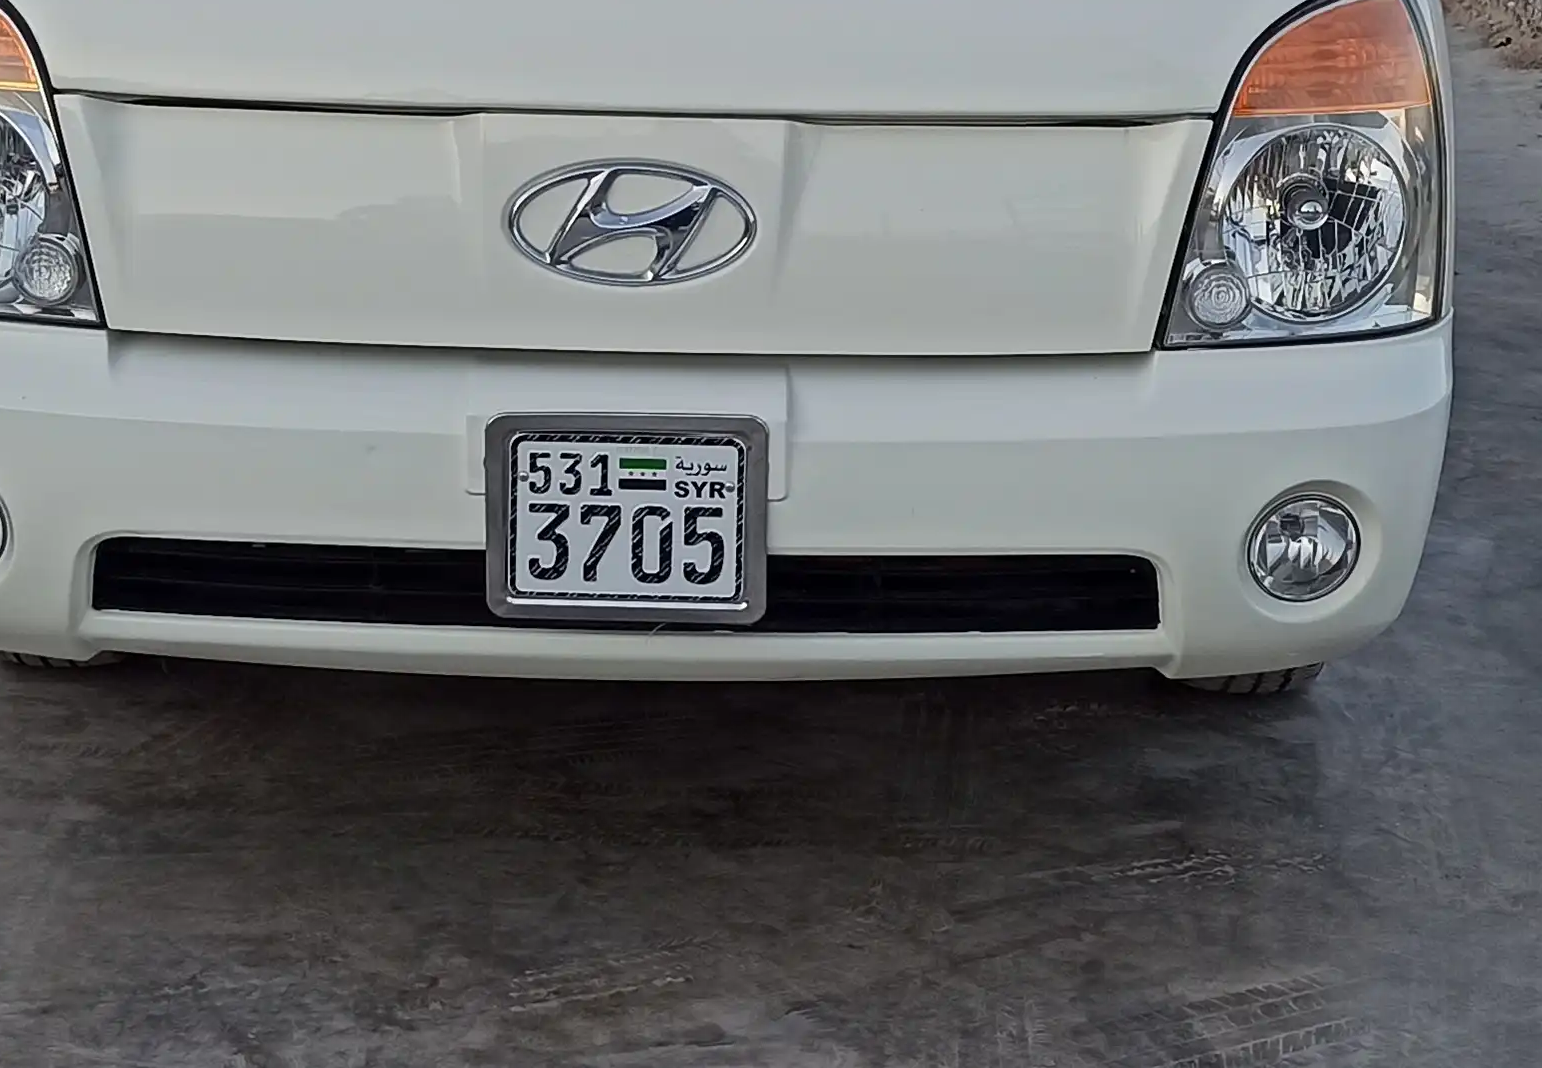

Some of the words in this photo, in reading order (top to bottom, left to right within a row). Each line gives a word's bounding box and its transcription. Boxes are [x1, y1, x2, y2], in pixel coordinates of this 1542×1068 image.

[528, 452, 613, 496] 531
[675, 455, 727, 476] سورية
[674, 480, 726, 499] SYR
[528, 502, 725, 585] 3705
